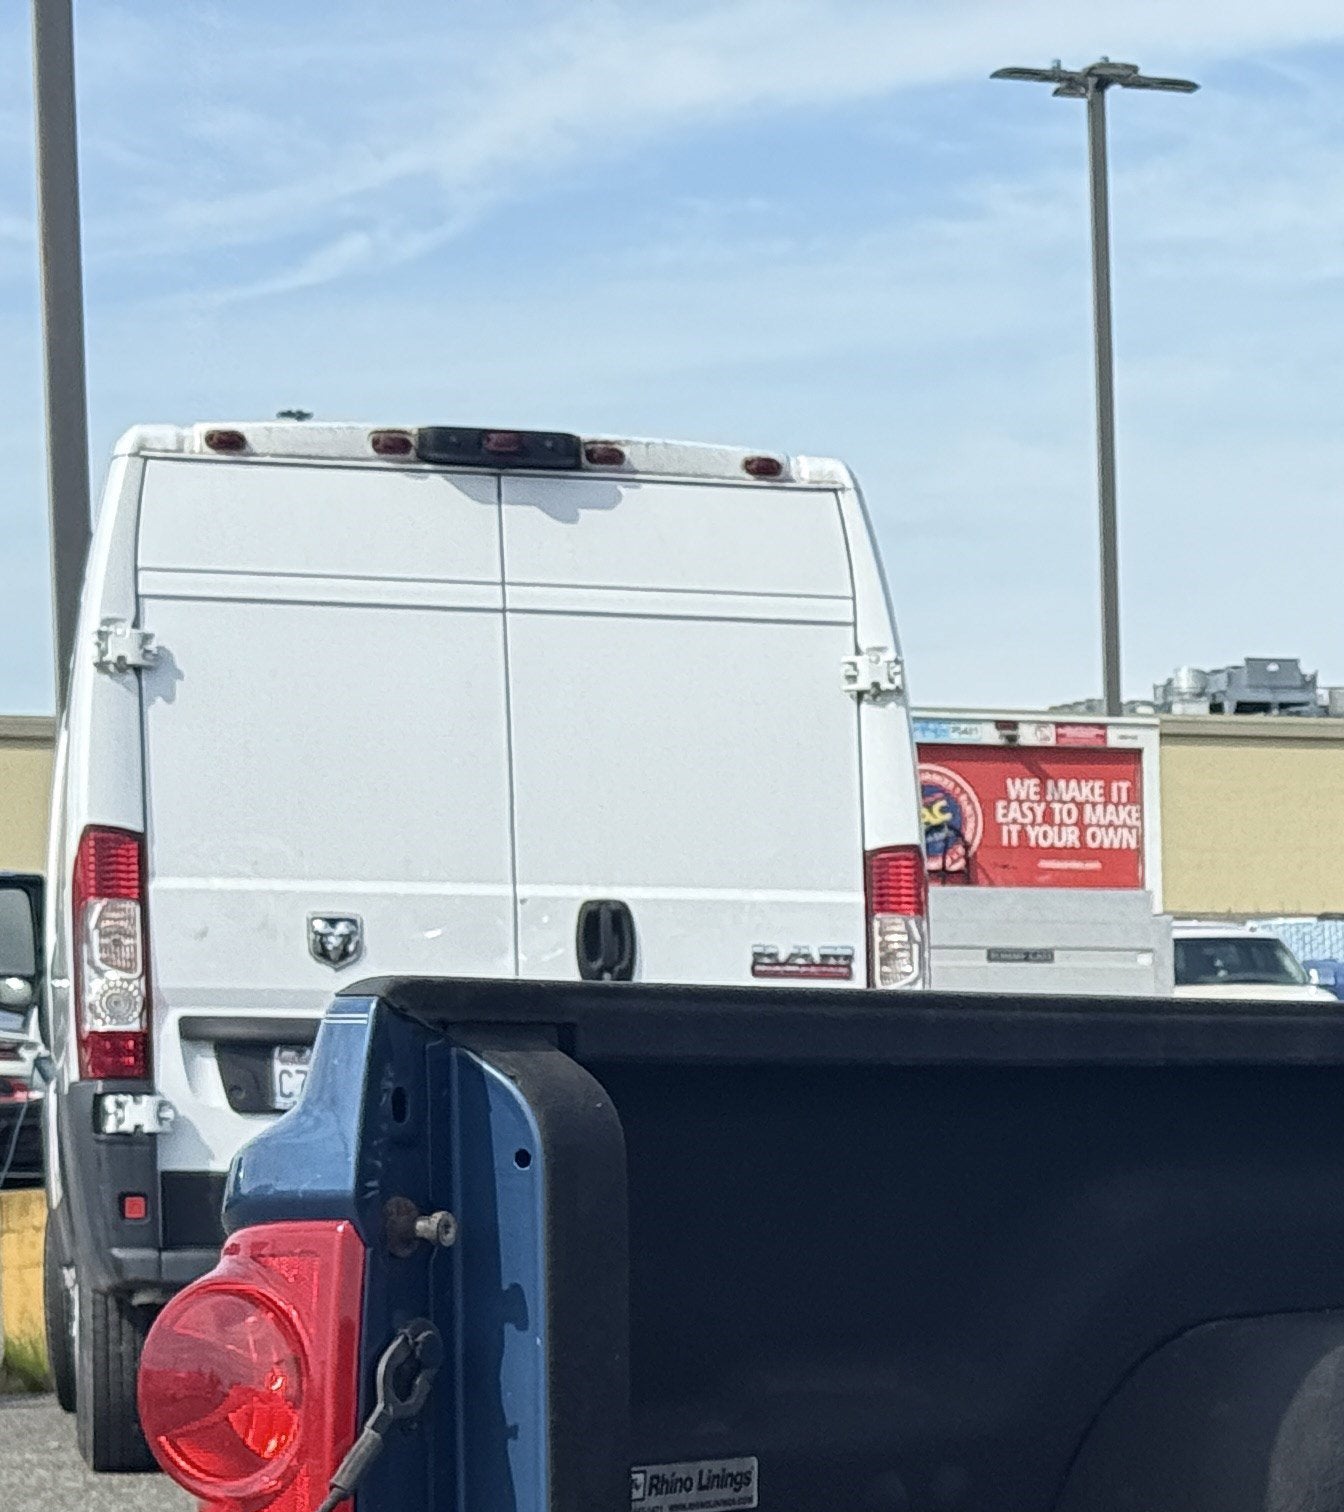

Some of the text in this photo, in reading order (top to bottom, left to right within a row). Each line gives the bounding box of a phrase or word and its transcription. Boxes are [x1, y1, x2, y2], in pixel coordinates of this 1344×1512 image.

[1006, 777, 1132, 803] WE MAKE IT
[995, 801, 1045, 824] EASY
[1052, 803, 1077, 825] TO
[1083, 804, 1141, 827] MAKE
[1000, 824, 1138, 849] IT YOUR OWN
[648, 1467, 752, 1497] Rhino Linings
